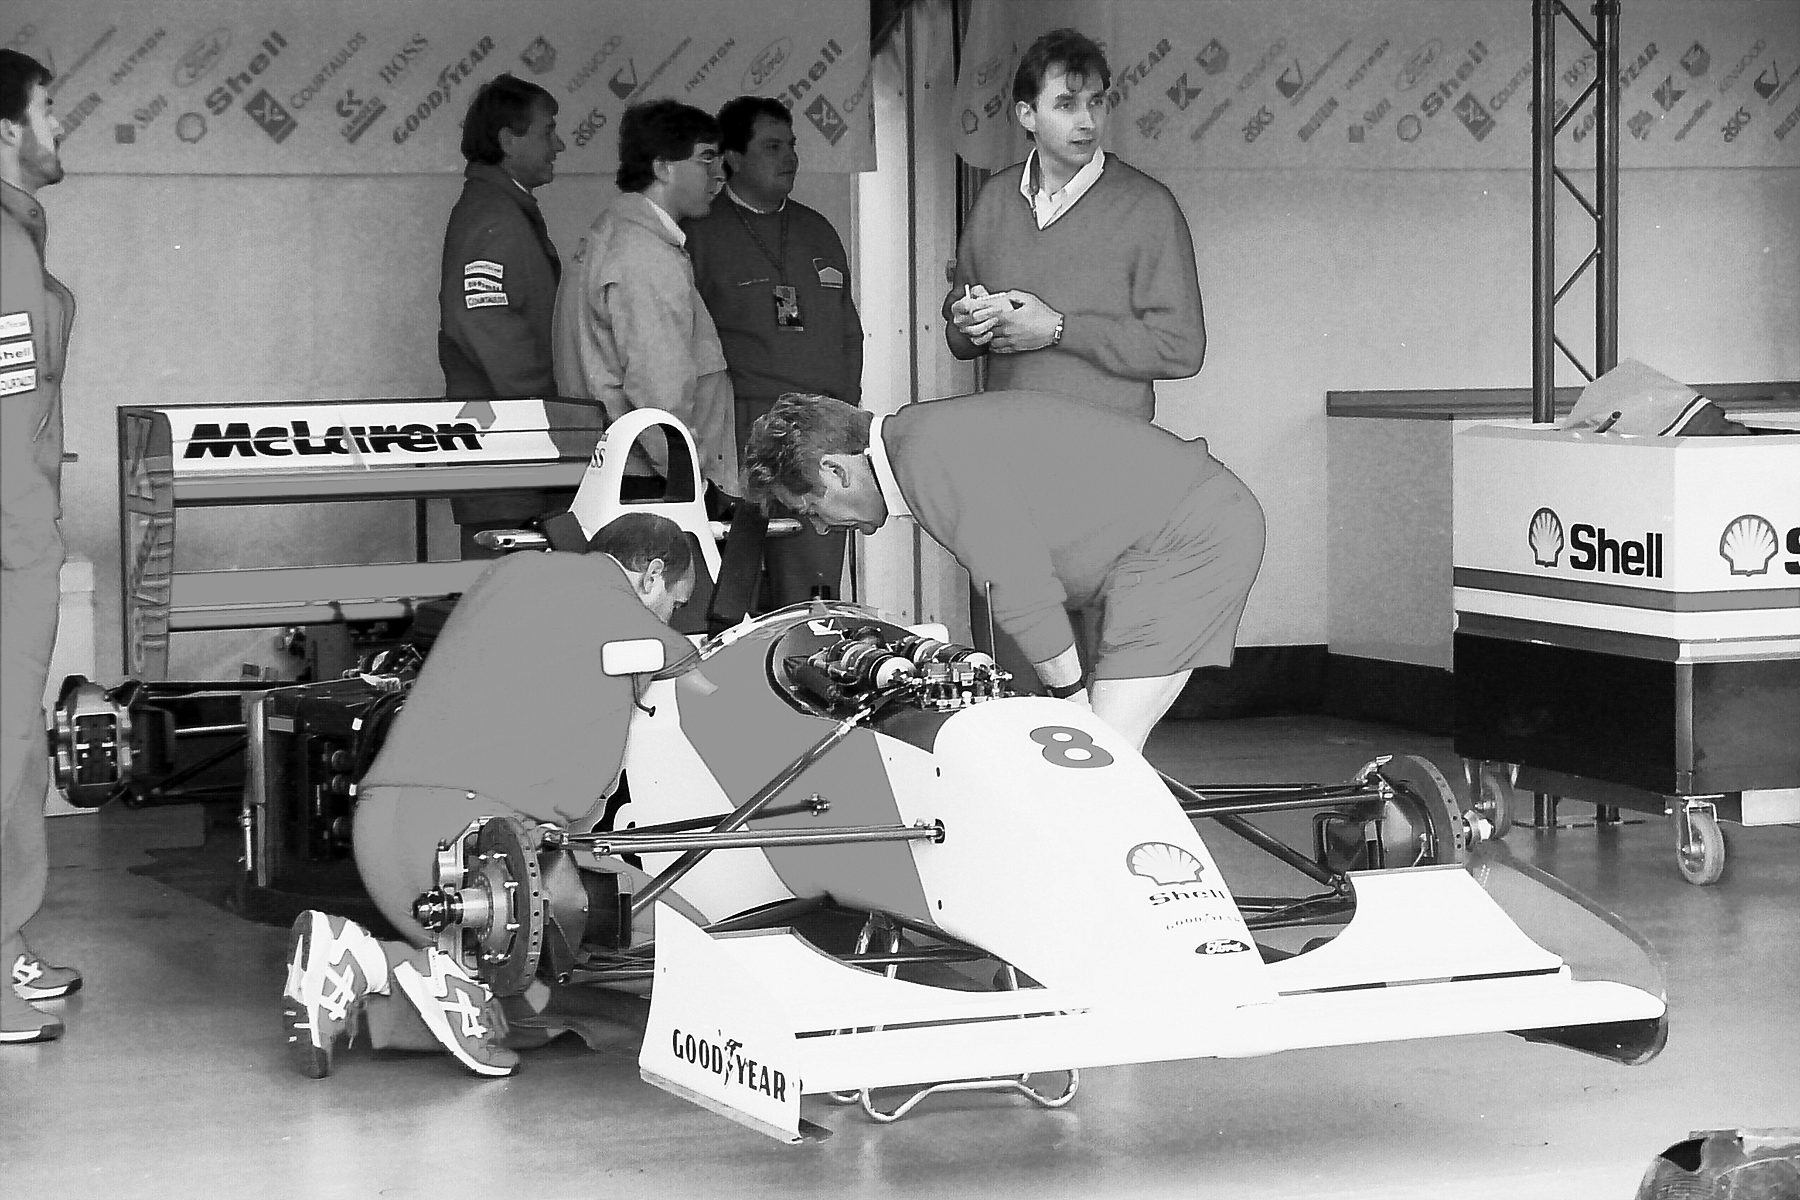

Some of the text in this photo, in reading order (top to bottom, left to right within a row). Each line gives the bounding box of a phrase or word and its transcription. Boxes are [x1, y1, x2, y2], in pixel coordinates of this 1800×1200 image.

[205, 30, 287, 116] Shell
[392, 35, 495, 144] GOODYEAR
[1422, 40, 1488, 118] Shell
[183, 420, 483, 459] McLaren
[1569, 523, 1663, 579] Shell
[1029, 725, 1115, 769] 8
[1149, 889, 1226, 906] Shell
[672, 1028, 786, 1103] GOODYEAR
